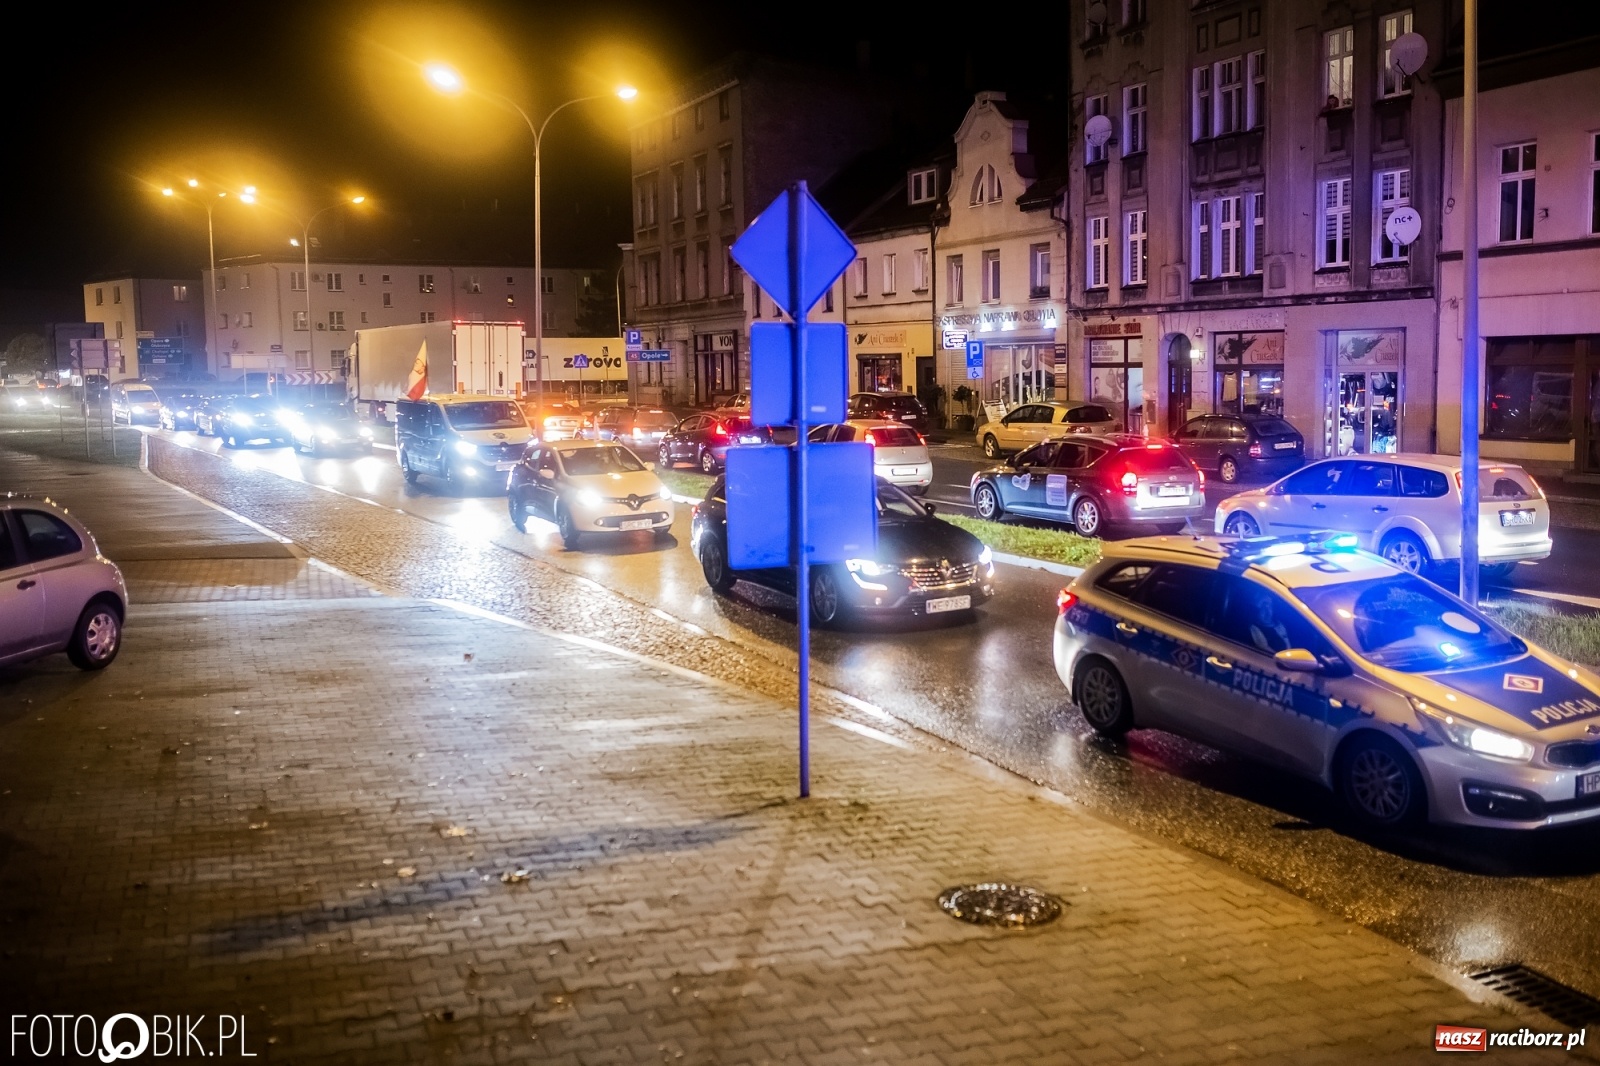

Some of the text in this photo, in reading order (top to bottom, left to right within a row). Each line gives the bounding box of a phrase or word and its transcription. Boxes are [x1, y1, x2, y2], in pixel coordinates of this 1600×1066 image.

[1394, 215, 1413, 224] nc+
[630, 331, 639, 343] P
[641, 352, 661, 360] Opole
[969, 343, 980, 359] P
[1233, 668, 1294, 706] POLICJA
[1530, 699, 1600, 724] POLICJA
